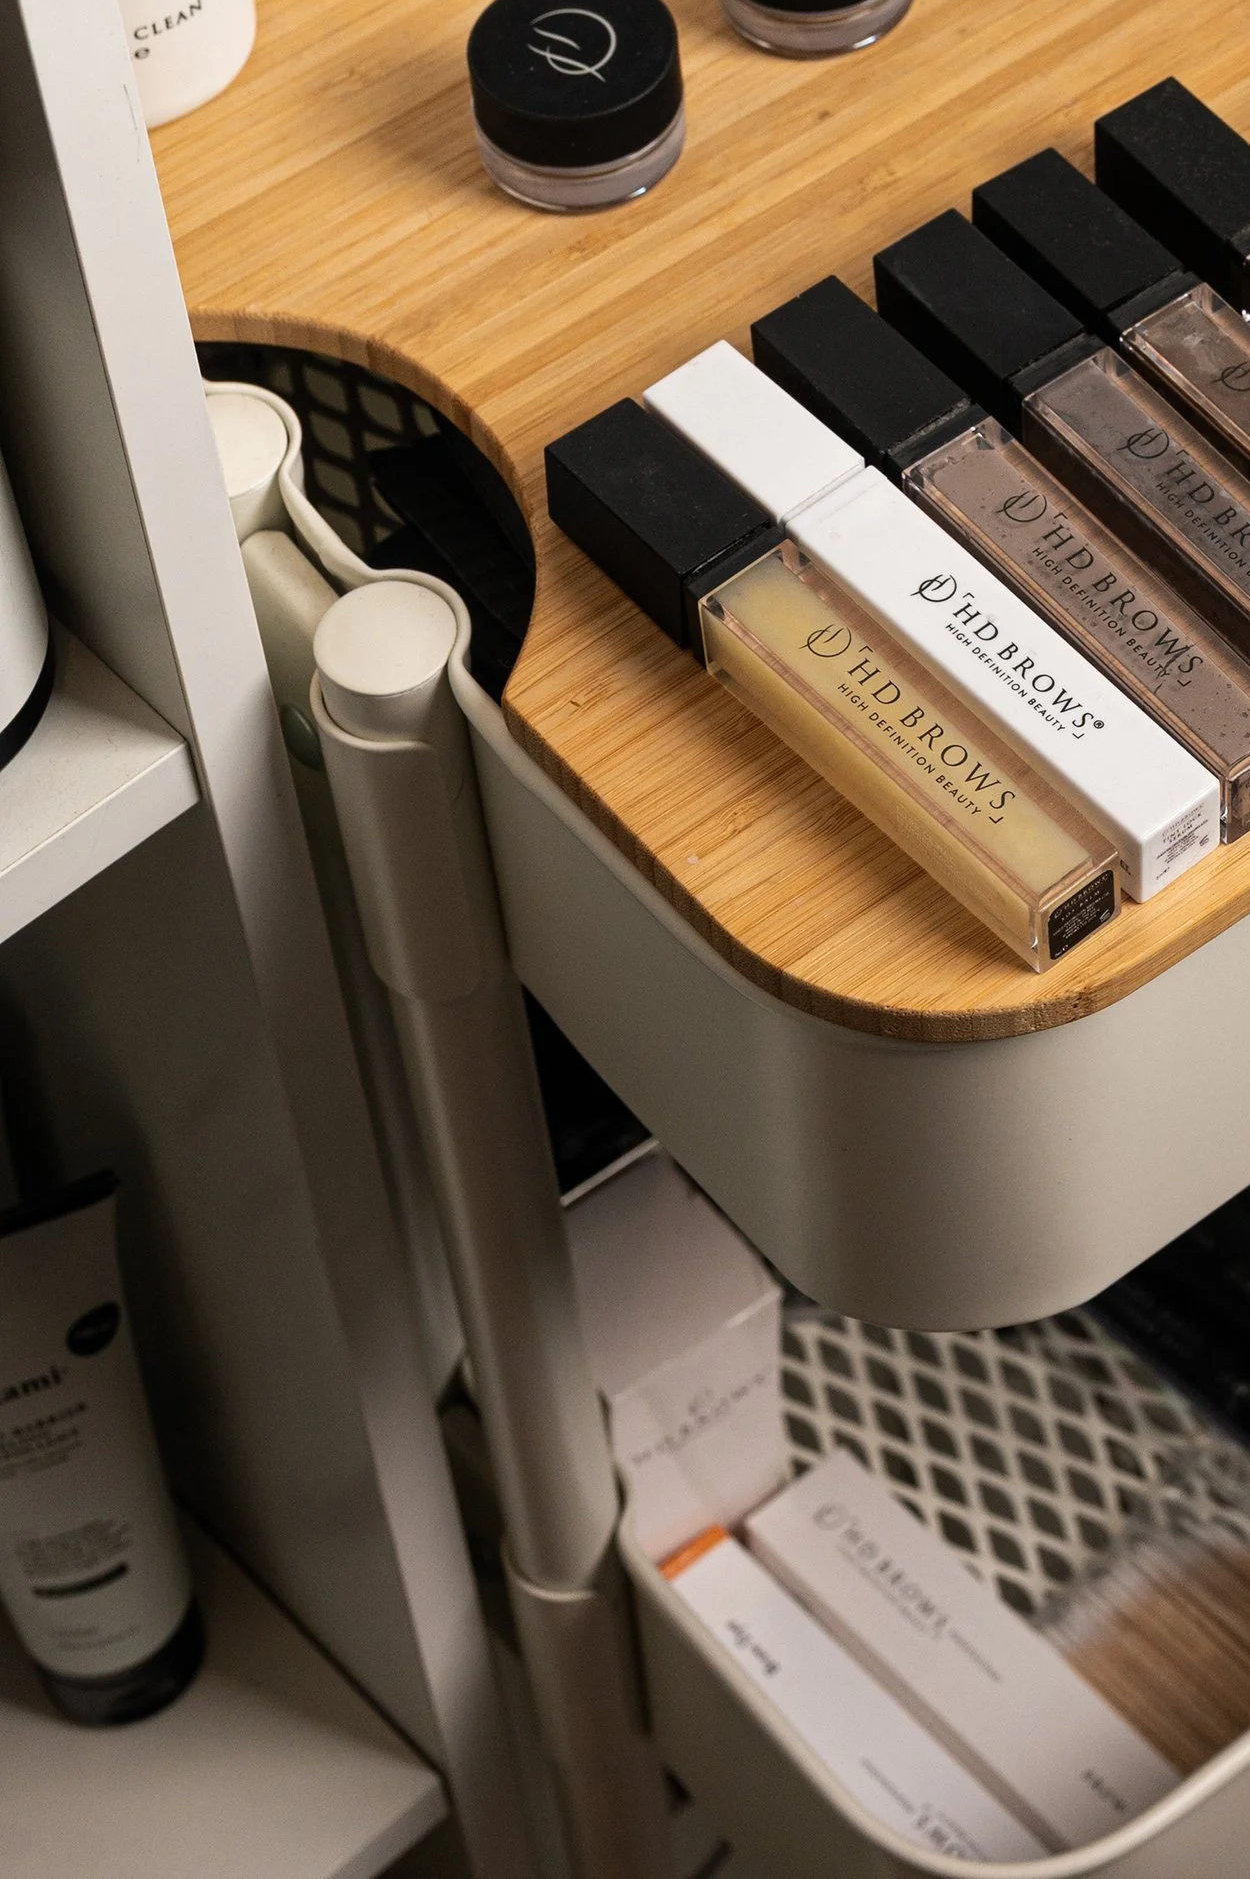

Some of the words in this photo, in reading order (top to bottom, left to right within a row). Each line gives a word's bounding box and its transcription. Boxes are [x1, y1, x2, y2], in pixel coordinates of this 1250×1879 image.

[1155, 482, 1188, 514] HIGH
[1184, 511, 1247, 568] DEFINITION
[1166, 460, 1215, 505] HD
[952, 602, 999, 641] HD
[1032, 547, 1061, 576] HIGH
[1062, 576, 1126, 637] DEFINITION
[1126, 638, 1170, 678] BEAUTY
[1042, 524, 1094, 570] HD
[1092, 572, 1204, 673] BROWS
[847, 657, 901, 705] HD
[899, 706, 1016, 810] BROWS
[945, 623, 973, 647] HIGH
[971, 646, 1028, 698] DEFINITION
[1027, 697, 1066, 732] BEAUTY
[837, 683, 869, 712] HIGH
[868, 712, 936, 775] DEFINITION
[935, 774, 982, 816] BEAUTY
